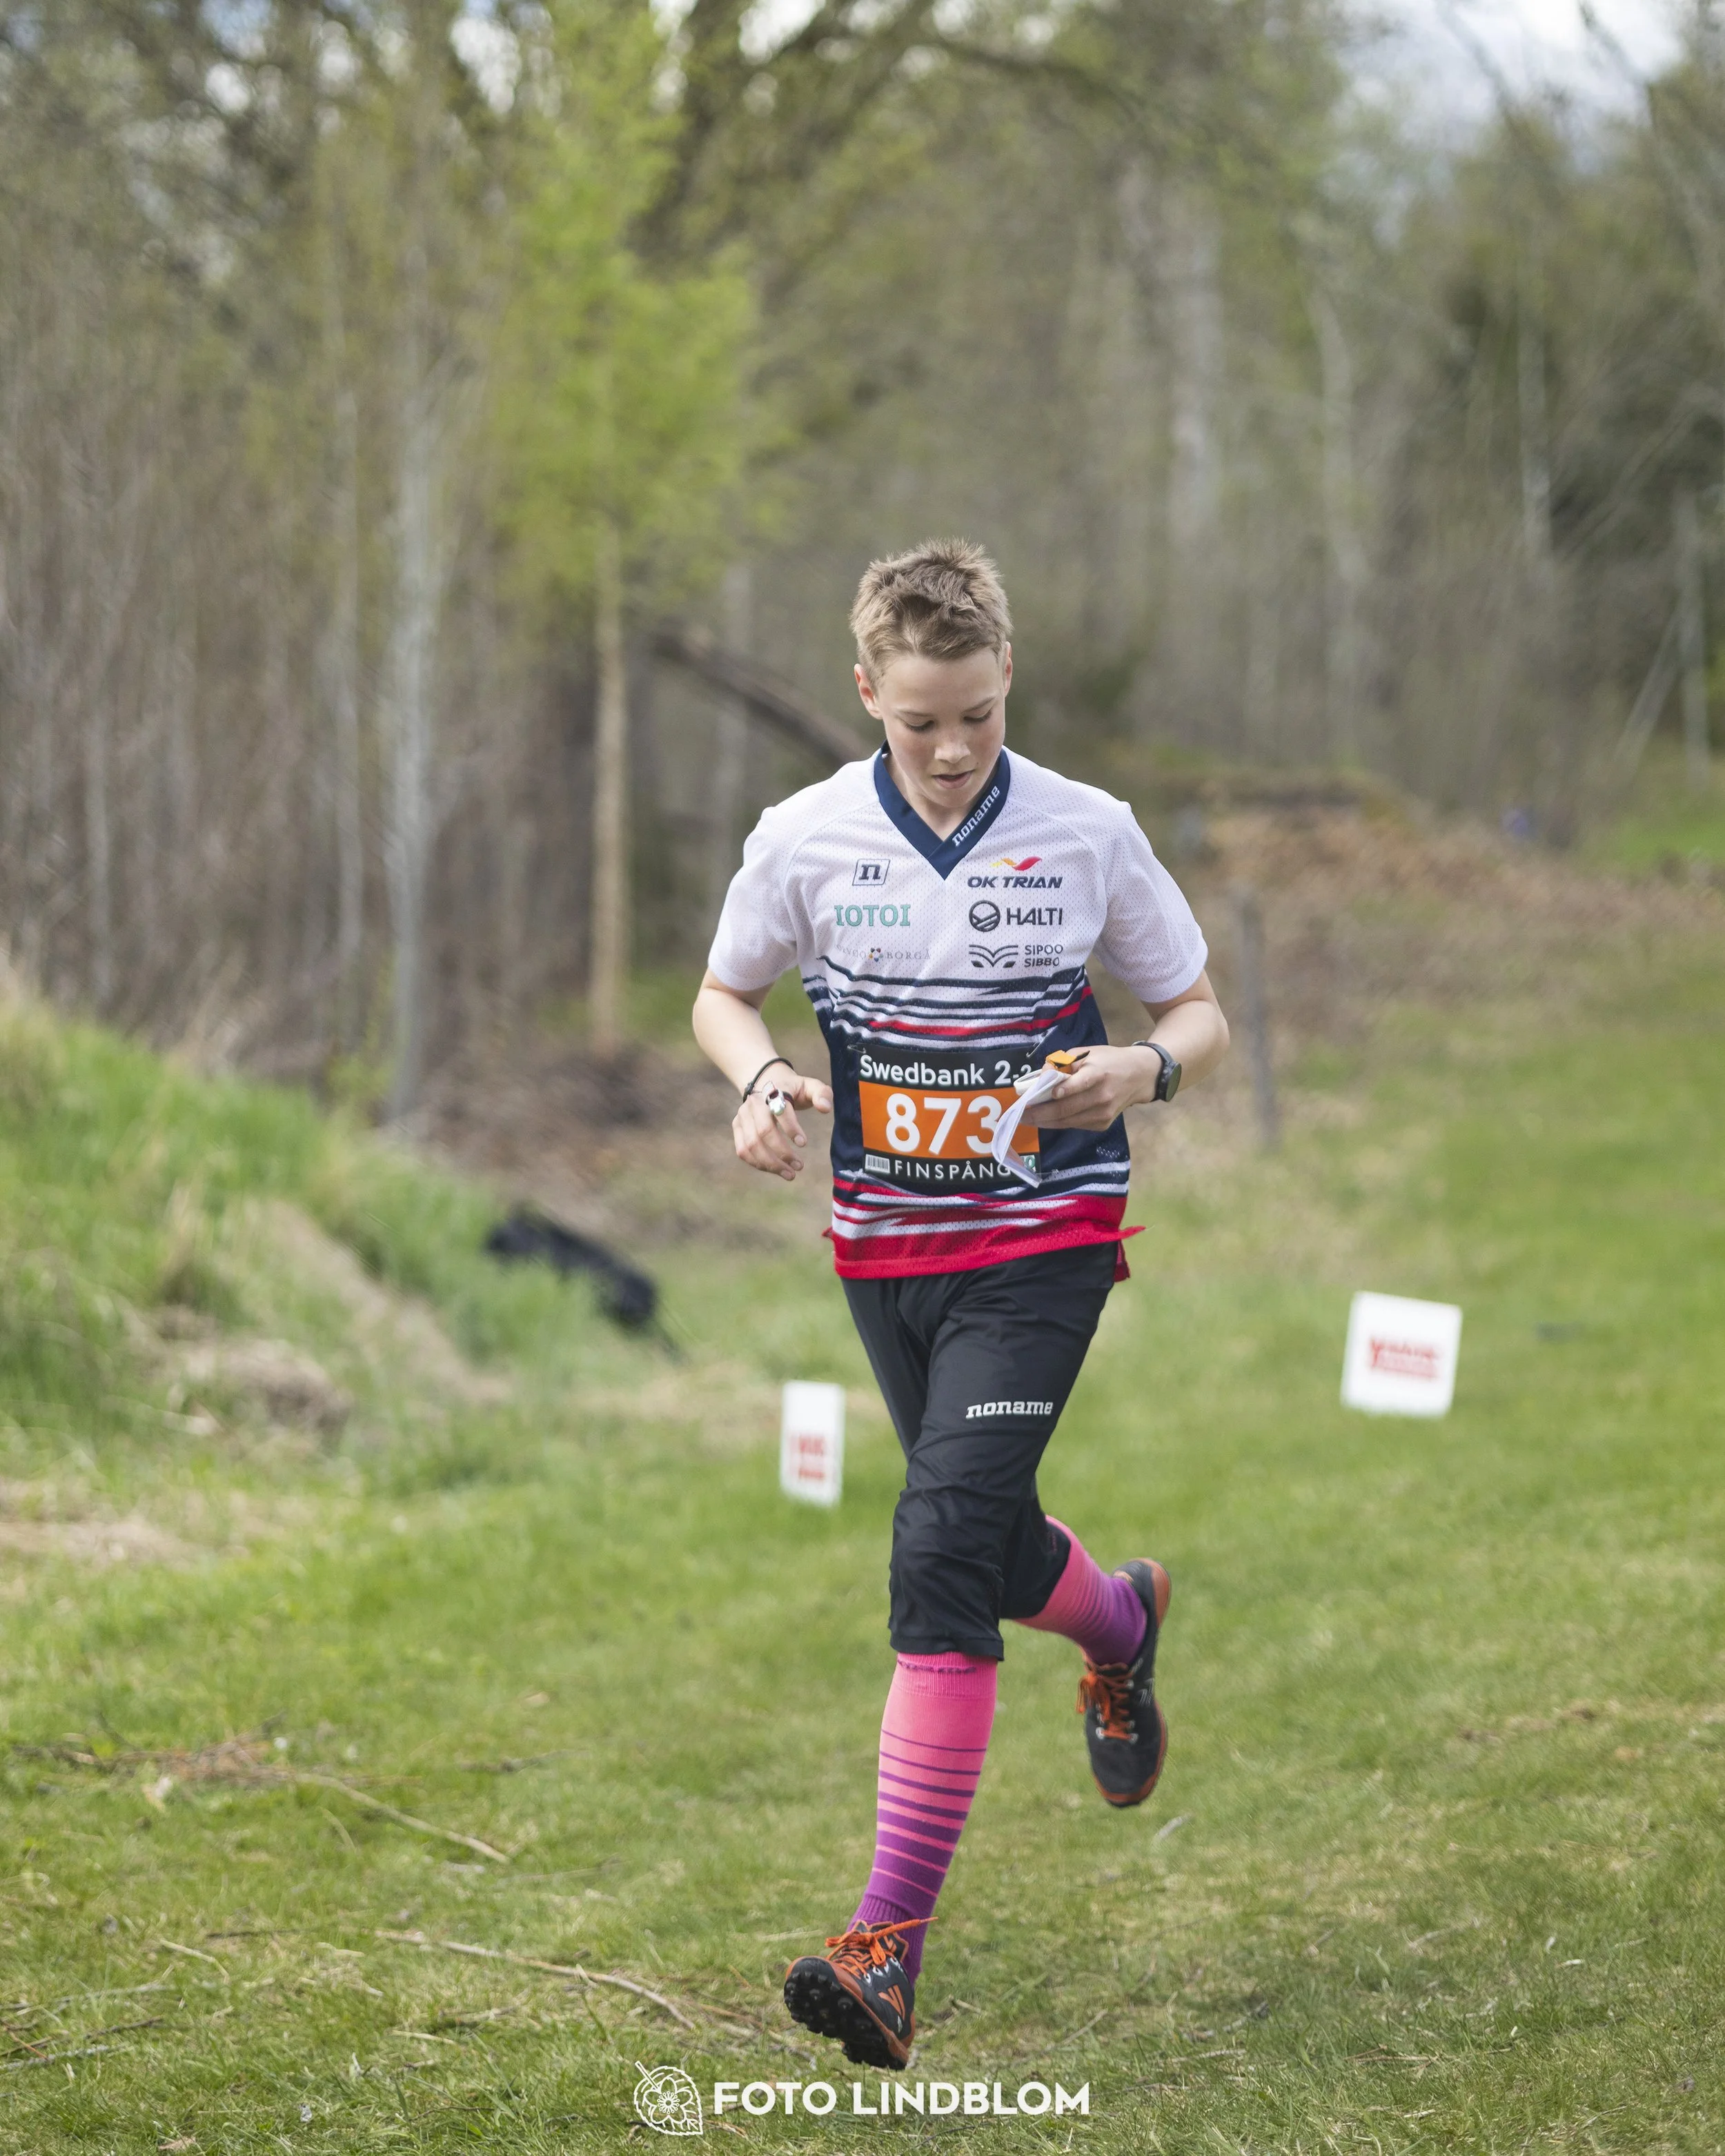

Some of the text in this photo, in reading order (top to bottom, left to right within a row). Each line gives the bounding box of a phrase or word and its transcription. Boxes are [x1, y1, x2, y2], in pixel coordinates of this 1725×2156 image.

[952, 785, 1000, 847] noname
[967, 876, 1063, 889] OK TRIAN
[834, 904, 911, 927] IOTOI
[1006, 907, 1063, 925] HALTI
[1024, 945, 1063, 956] SIPOO
[1023, 957, 1061, 967] SIBBO
[860, 1054, 985, 1086] Swedbank
[885, 1093, 1003, 1155] 873
[894, 1159, 1012, 1180] FINSPÅNG
[965, 1401, 1054, 1419] noname
